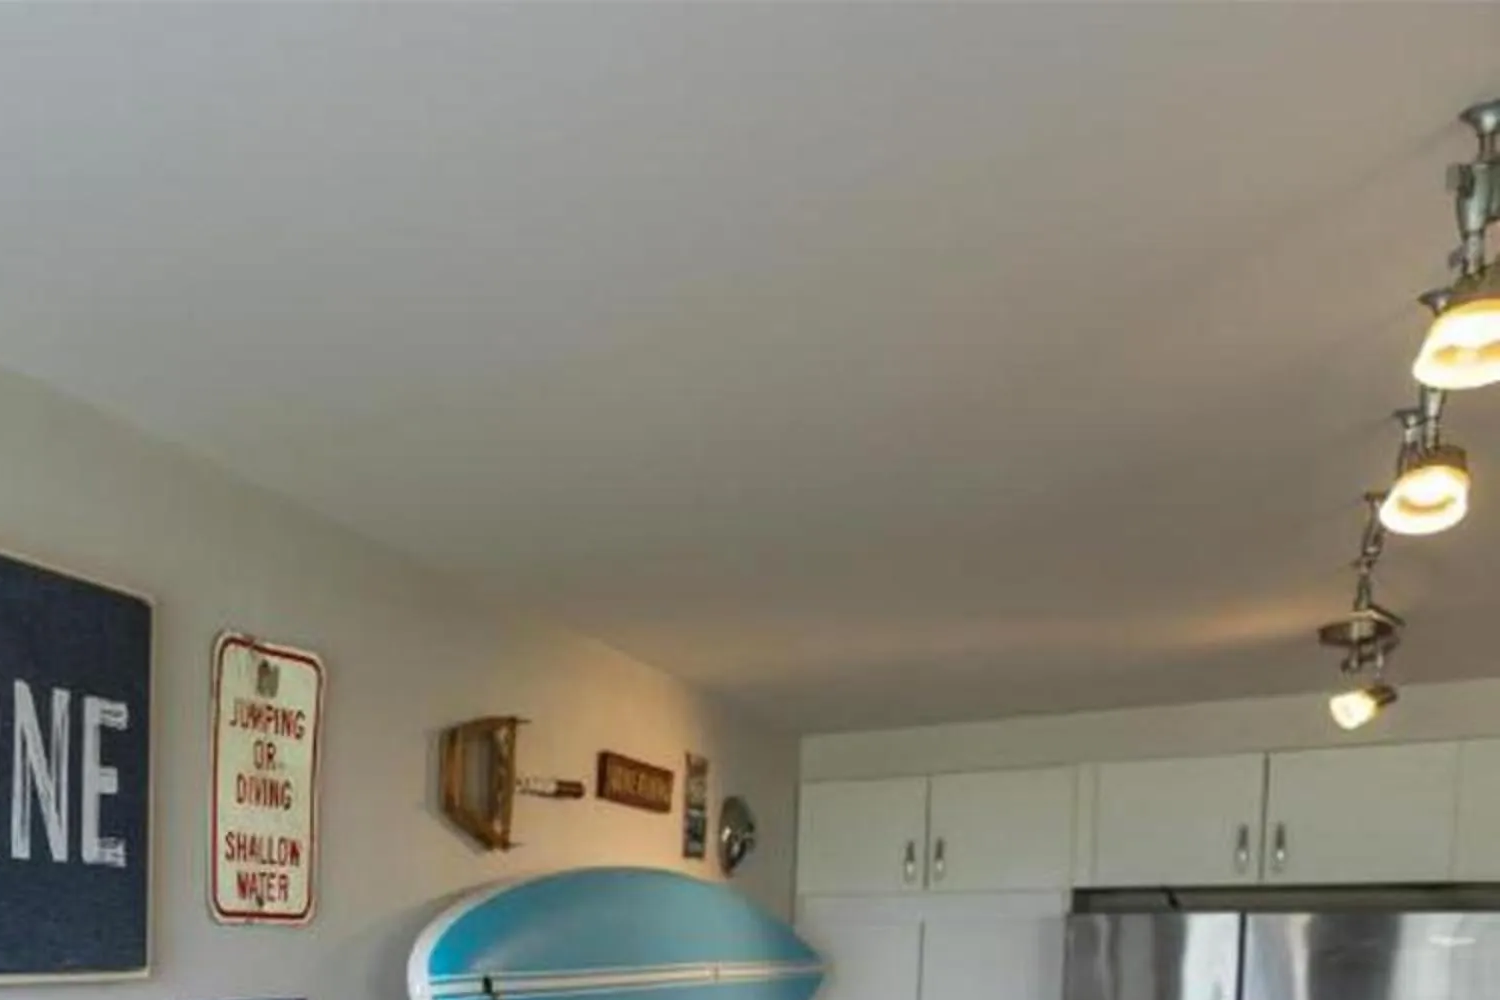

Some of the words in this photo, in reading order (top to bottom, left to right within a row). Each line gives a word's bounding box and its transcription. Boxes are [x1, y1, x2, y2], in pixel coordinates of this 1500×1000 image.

[229, 699, 306, 740] JUMPING
[253, 740, 277, 771] OR
[236, 773, 292, 811] DIVING
[225, 831, 303, 867] SHALLOW
[237, 871, 289, 902] WATER
